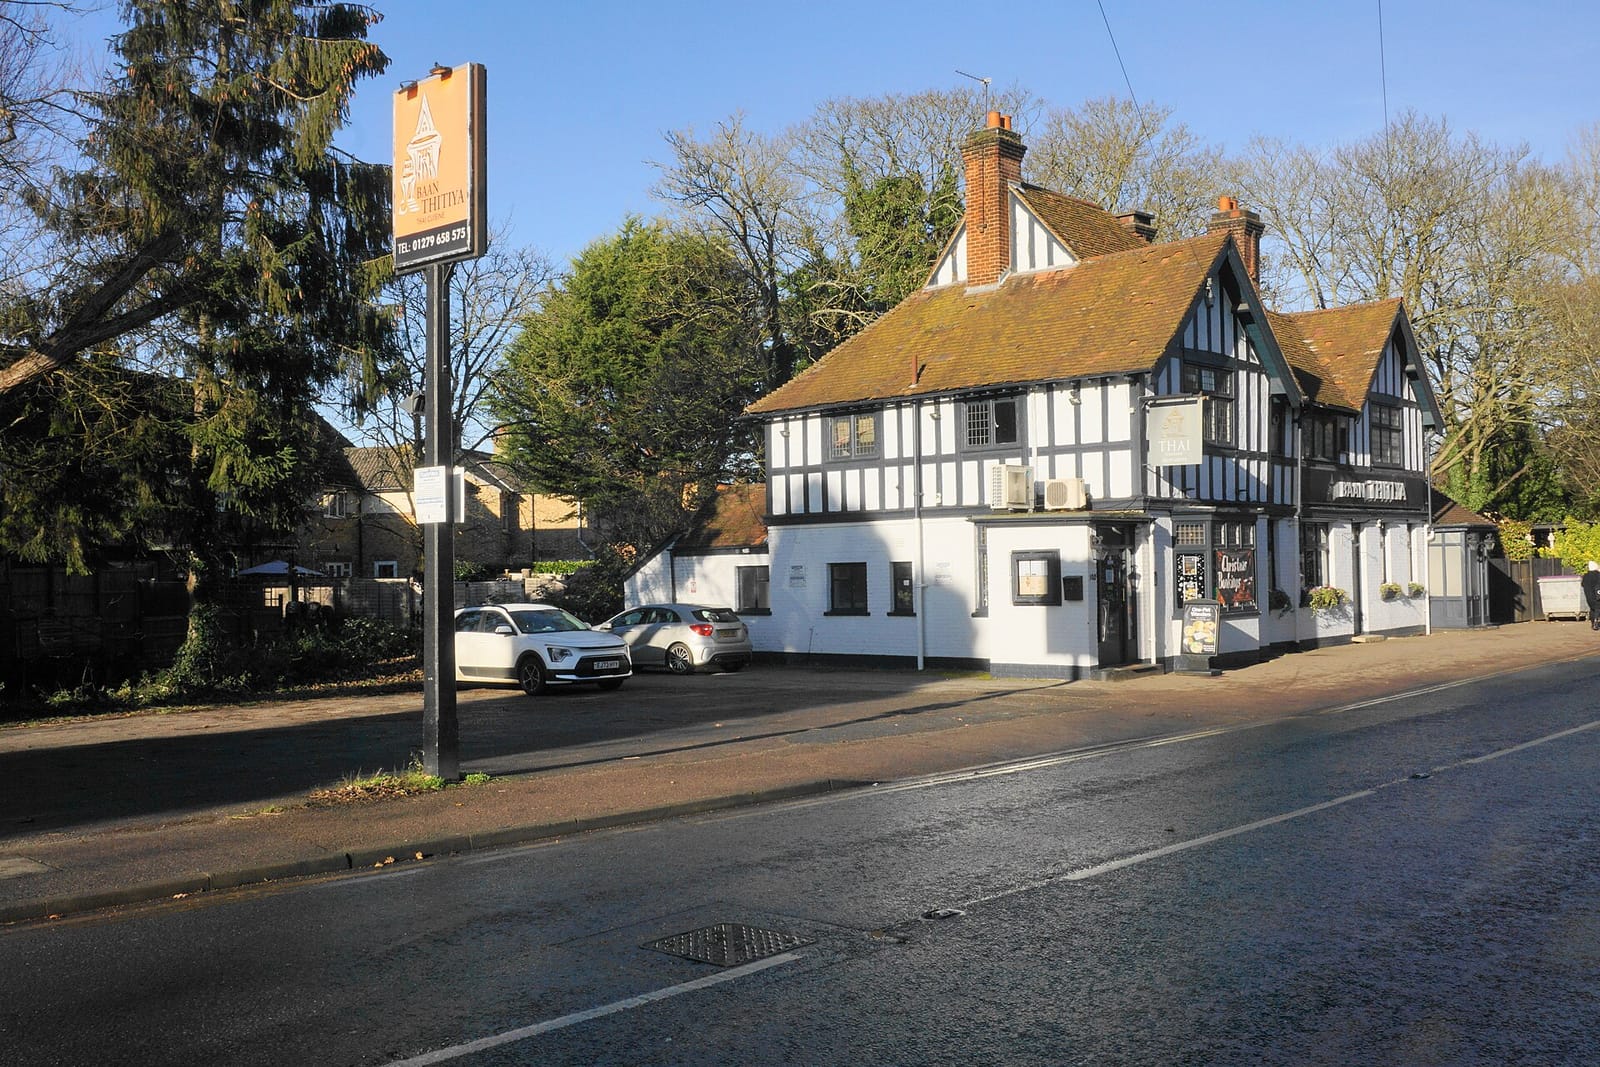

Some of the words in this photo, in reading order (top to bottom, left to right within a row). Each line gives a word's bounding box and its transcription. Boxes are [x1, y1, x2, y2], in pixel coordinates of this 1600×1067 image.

[416, 181, 439, 199] BAAN
[422, 189, 464, 214] THITIYA
[397, 242, 411, 254] TEL:
[412, 235, 435, 251] 01279
[436, 231, 450, 245] 658
[451, 227, 466, 241] 575
[1158, 439, 1191, 452] THAI
[1334, 481, 1365, 499] BAAN
[1365, 480, 1406, 501] THITIYA
